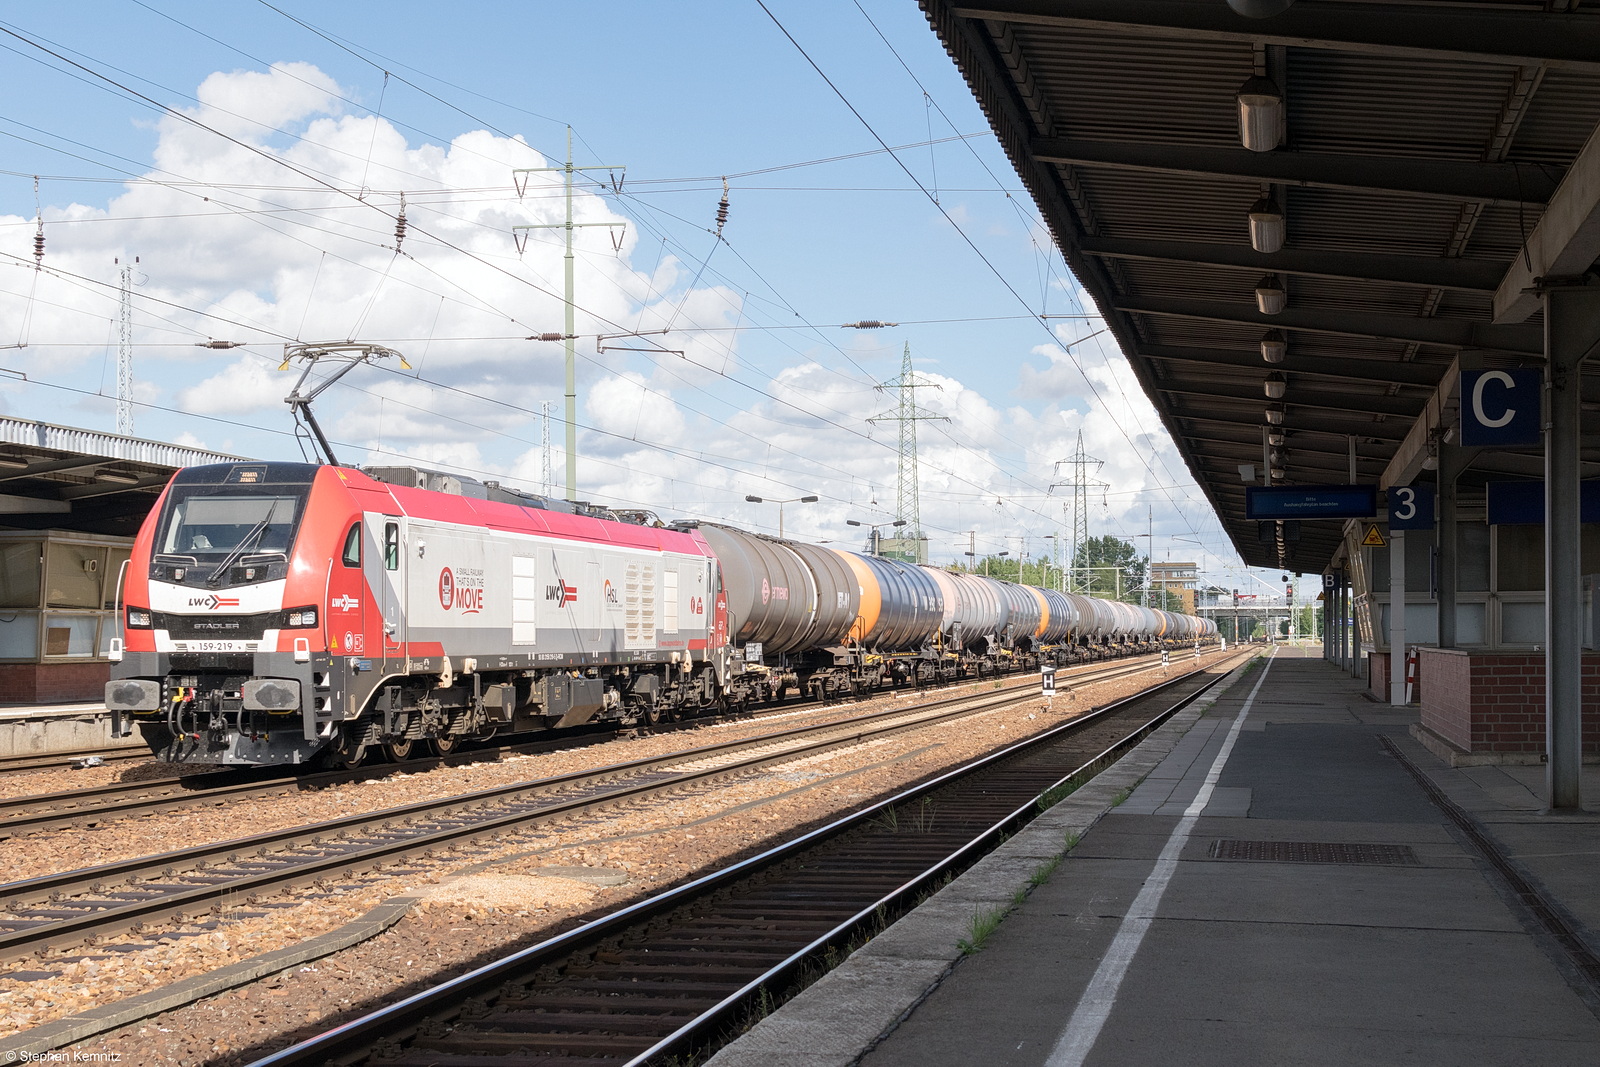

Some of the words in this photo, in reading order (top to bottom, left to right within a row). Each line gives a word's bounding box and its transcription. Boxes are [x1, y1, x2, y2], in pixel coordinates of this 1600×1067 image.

[1472, 370, 1516, 428] C
[1394, 487, 1416, 520] 3
[1325, 574, 1335, 587] B
[456, 587, 484, 609] MOVE
[545, 585, 560, 601] LWC
[188, 598, 211, 607] LWC
[331, 598, 345, 608] LWC
[199, 642, 233, 651] 159-219
[1162, 654, 1169, 662] H
[1043, 674, 1054, 688] H
